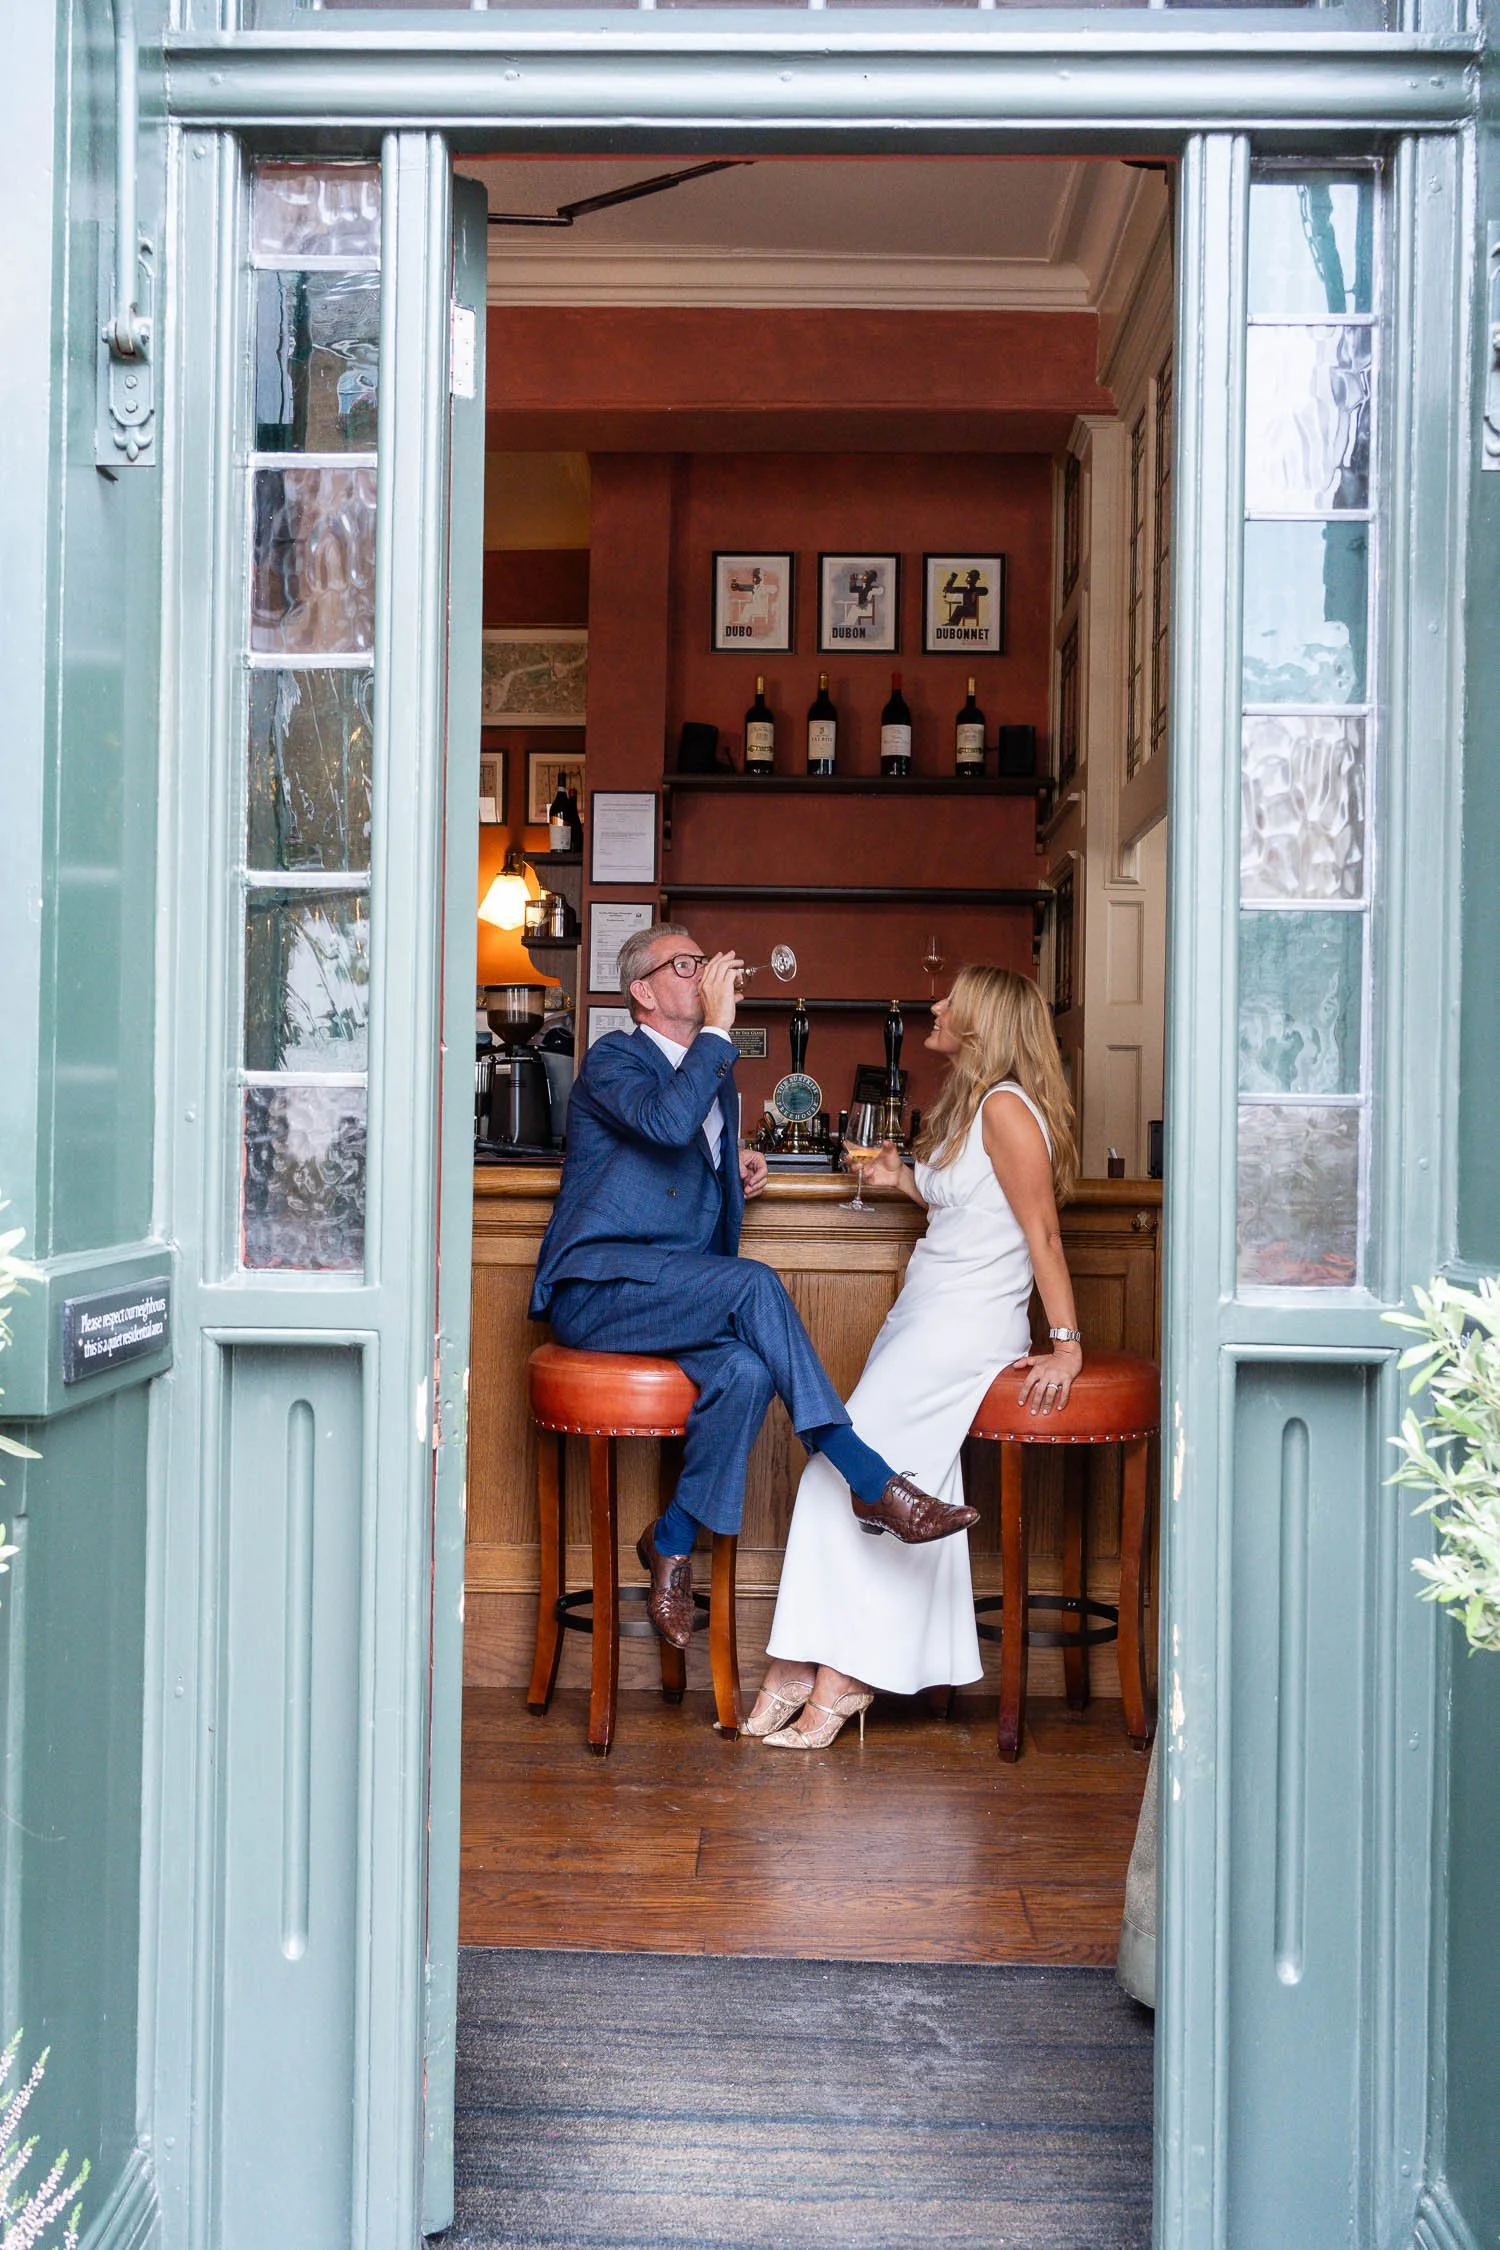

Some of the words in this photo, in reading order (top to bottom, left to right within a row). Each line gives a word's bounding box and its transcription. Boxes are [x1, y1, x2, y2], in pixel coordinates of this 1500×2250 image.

[725, 625, 753, 637] DUBO
[832, 627, 866, 639] DUBON
[936, 627, 990, 640] DUBONNET
[81, 1313, 102, 1333] Please
[102, 1309, 125, 1331] respect
[124, 1306, 135, 1321] our
[84, 1339, 97, 1358] this
[97, 1337, 103, 1354] is
[102, 1340, 108, 1353] a
[107, 1332, 123, 1357] quiet
[123, 1320, 152, 1345] residential
[152, 1322, 163, 1336] area
